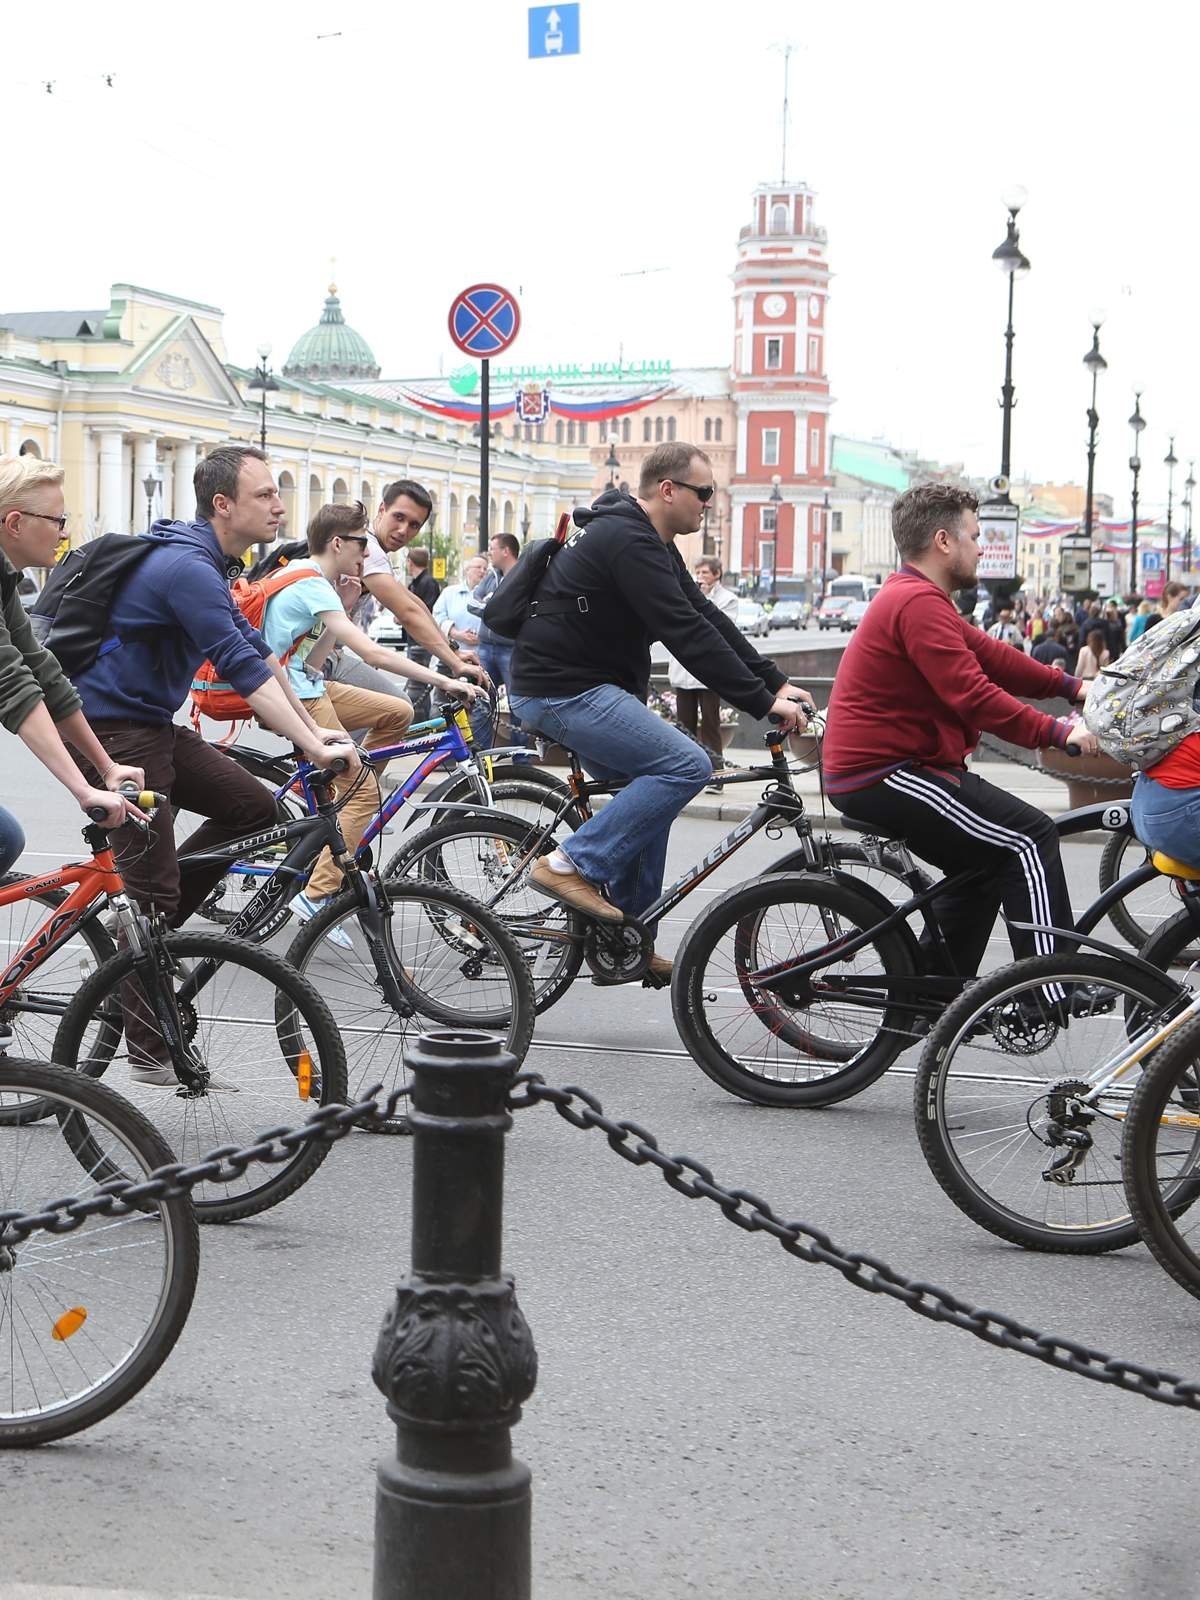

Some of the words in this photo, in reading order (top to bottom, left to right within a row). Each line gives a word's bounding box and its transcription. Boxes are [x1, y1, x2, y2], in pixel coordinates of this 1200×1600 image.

[403, 735, 443, 750] ROUTER
[1109, 809, 1121, 826] 8
[229, 827, 288, 854] 3900
[670, 817, 753, 892] STELS
[24, 876, 64, 893] OAHU
[227, 876, 283, 938] REK
[258, 909, 286, 937] WTB
[926, 1045, 948, 1121] STELS
